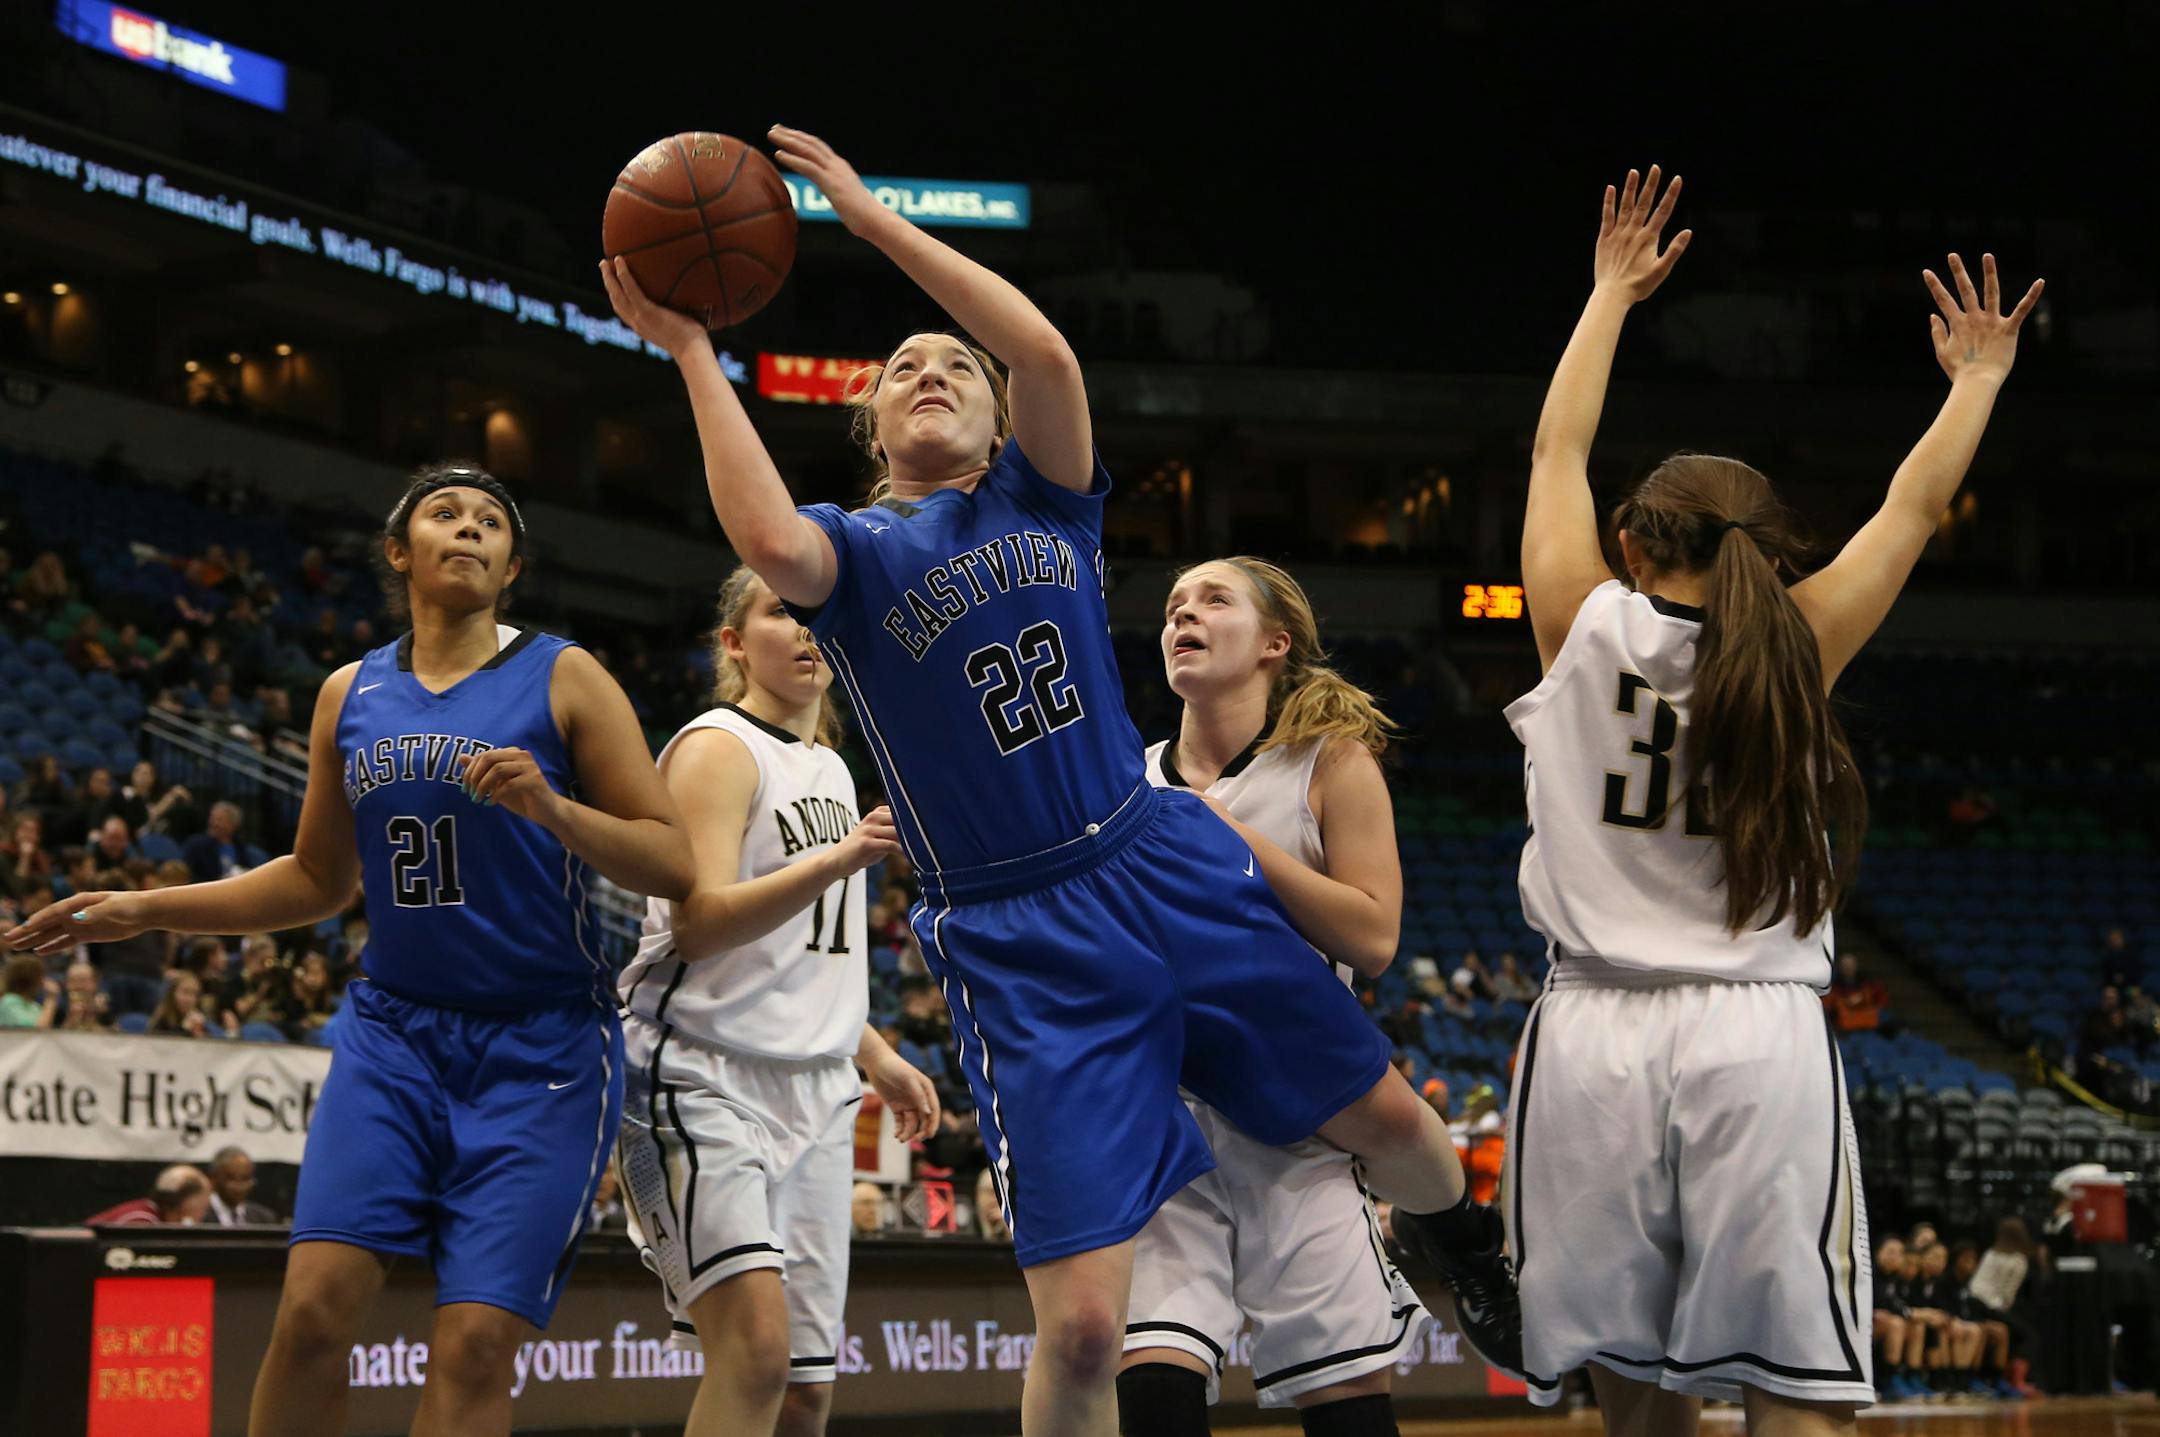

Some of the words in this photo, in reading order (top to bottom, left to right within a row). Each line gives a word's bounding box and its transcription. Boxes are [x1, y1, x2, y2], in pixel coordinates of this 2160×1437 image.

[83, 161, 142, 198] your
[146, 173, 248, 231] financial
[321, 227, 382, 272] Wells
[384, 247, 446, 294] Fargo
[447, 266, 468, 298] is
[469, 278, 515, 312] with
[882, 531, 1077, 663] EASTVIEW
[1462, 584, 1523, 619] 2:36
[964, 619, 1085, 757] 22
[344, 734, 494, 809] EASTVI
[386, 816, 465, 908] 21
[774, 796, 858, 857] ANDOV
[119, 1070, 229, 1147] High
[511, 1339, 601, 1398] your
[880, 1320, 968, 1373] Wells
